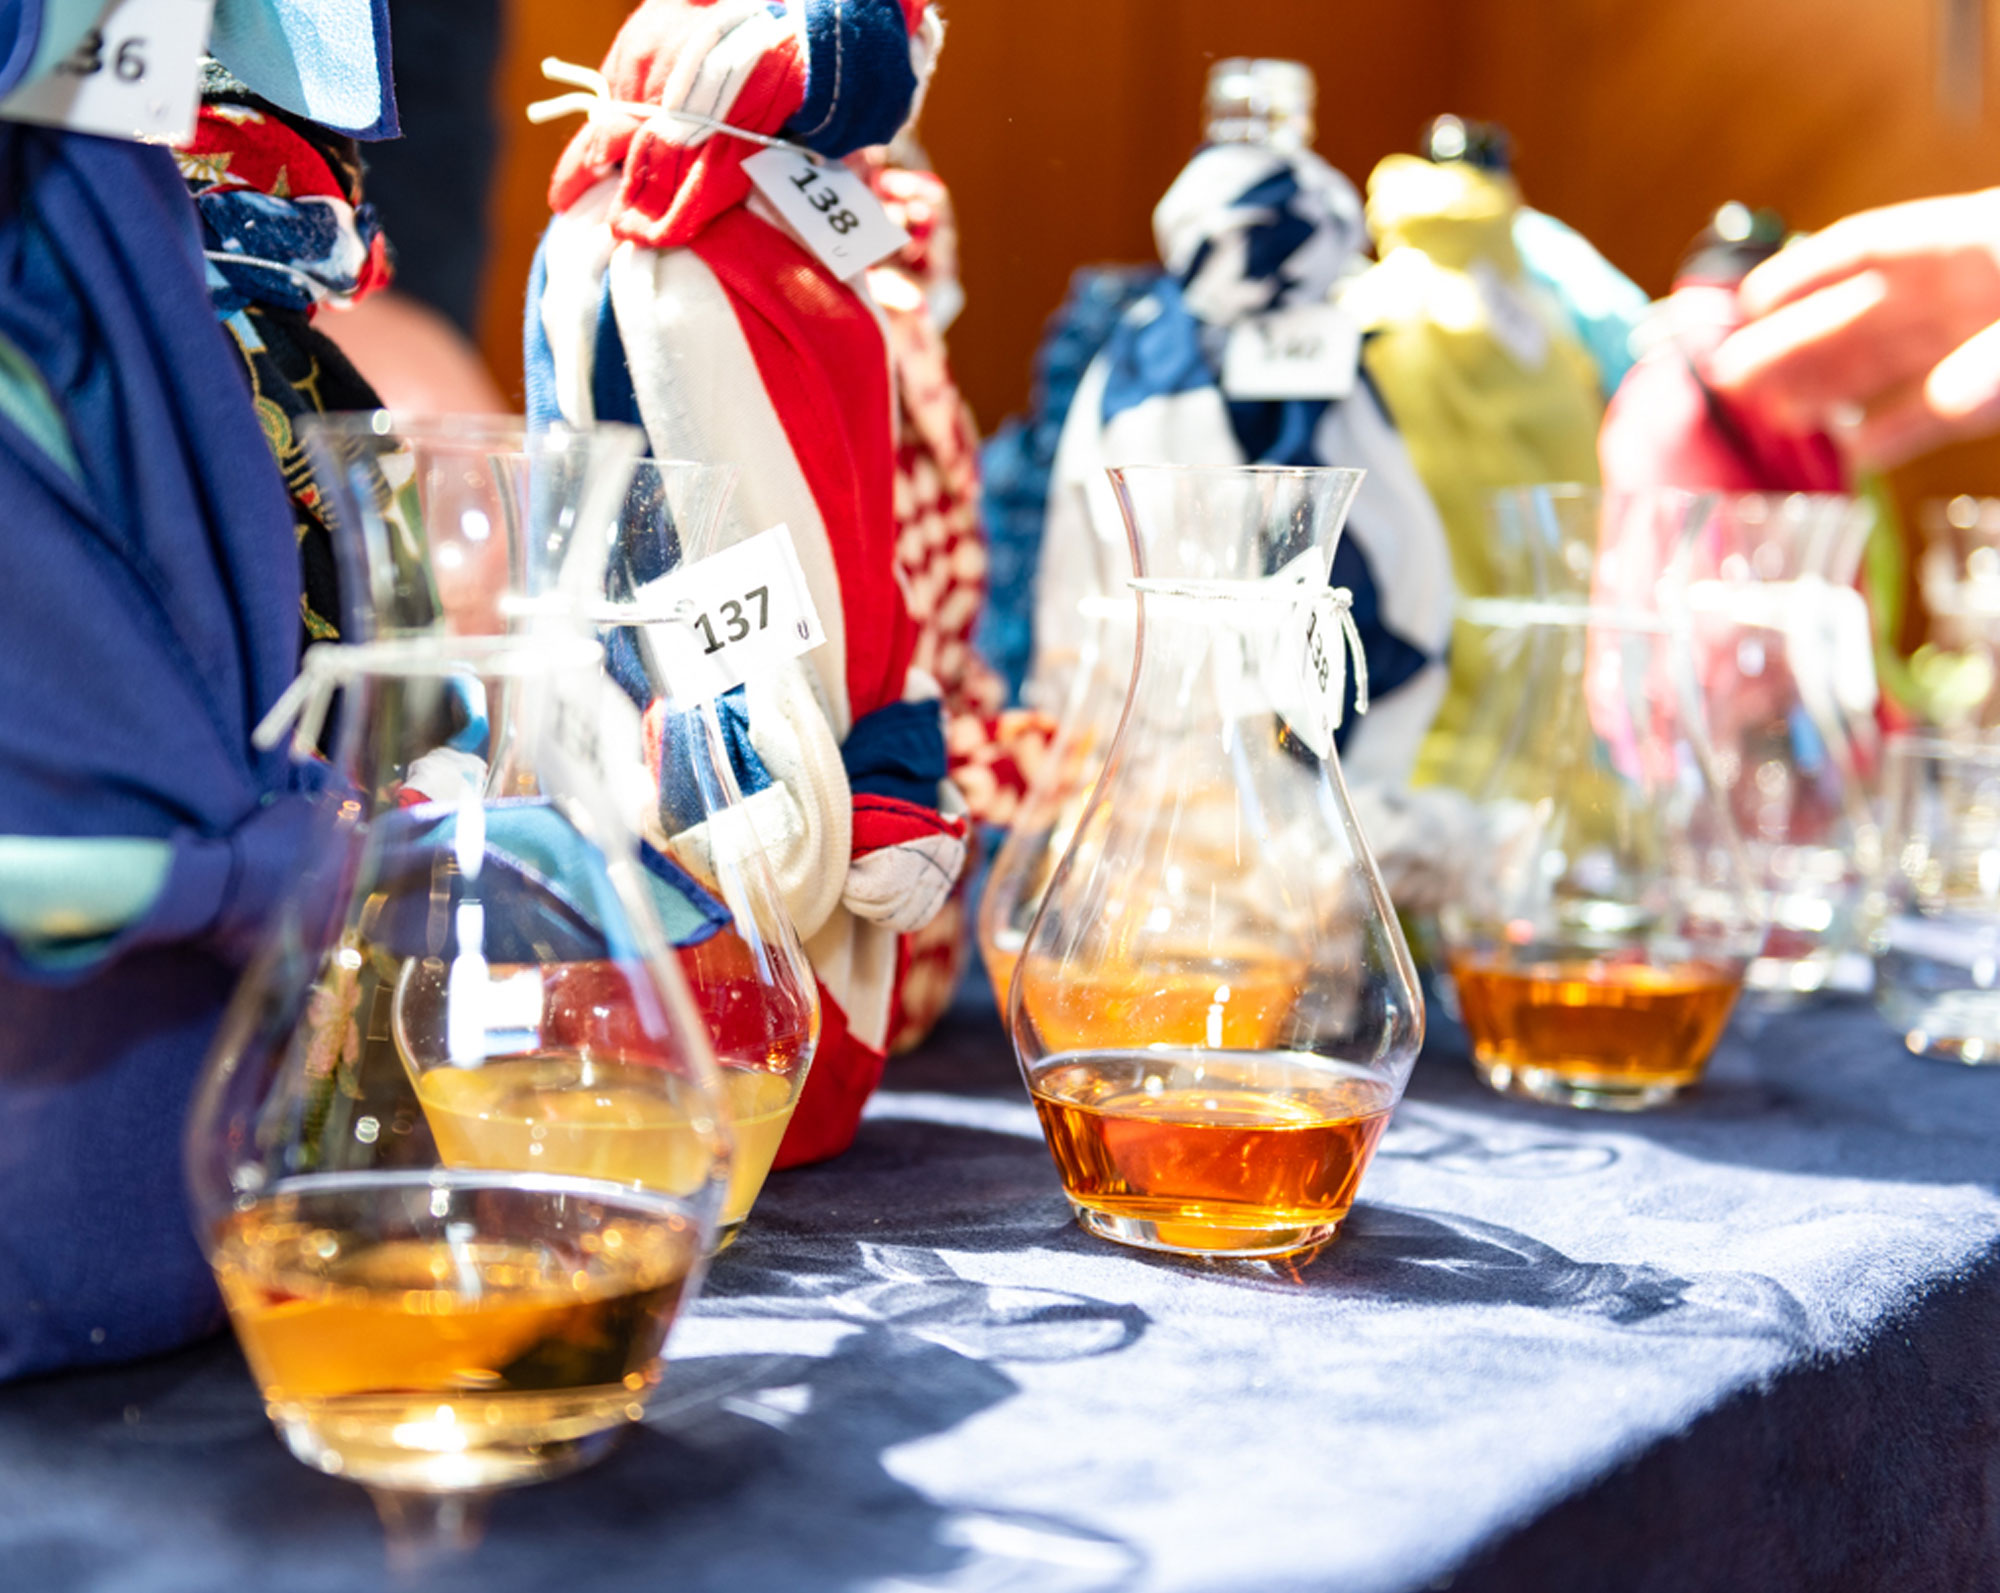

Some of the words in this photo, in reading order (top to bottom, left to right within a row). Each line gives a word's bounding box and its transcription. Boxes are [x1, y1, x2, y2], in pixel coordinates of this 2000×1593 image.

[789, 167, 859, 235] 138
[693, 585, 769, 655] 137
[1306, 610, 1329, 694] 138
